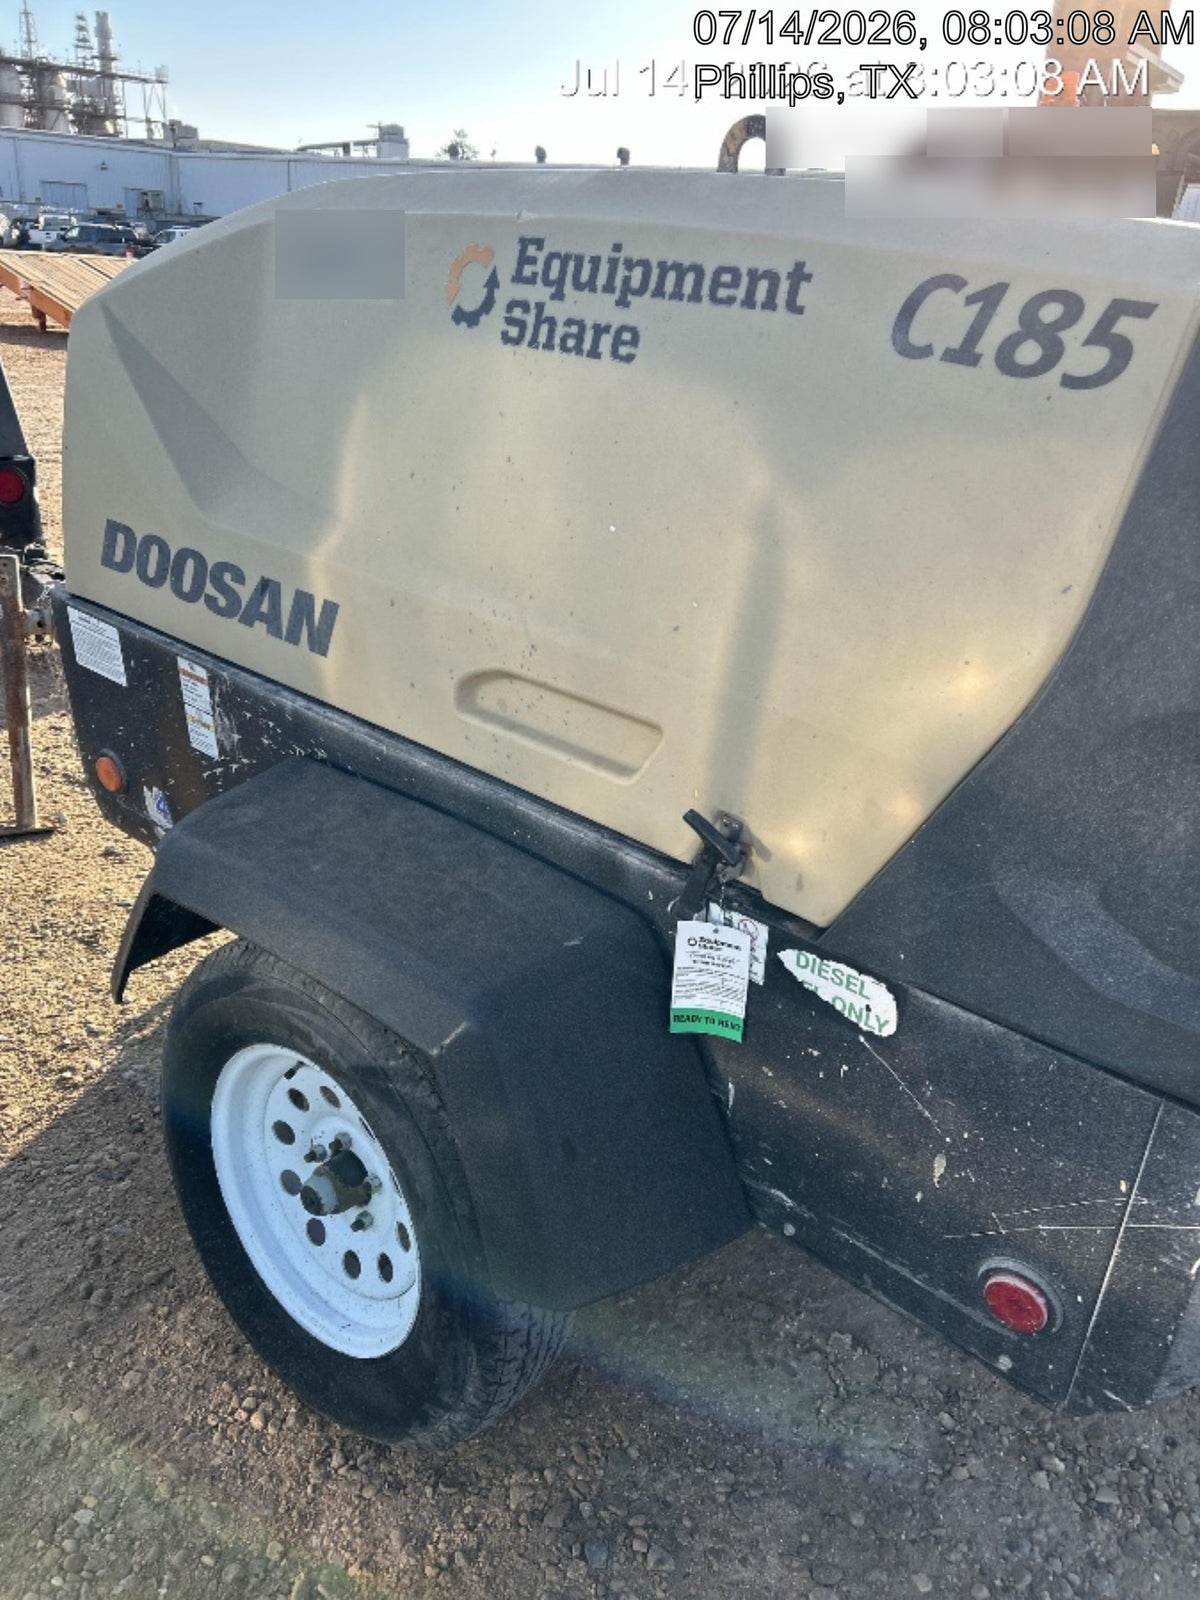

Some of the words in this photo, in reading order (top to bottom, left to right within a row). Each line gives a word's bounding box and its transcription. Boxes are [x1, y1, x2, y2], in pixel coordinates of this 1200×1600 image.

[510, 235, 813, 315] Equipment
[500, 299, 640, 364] Share
[891, 272, 1160, 390] C185
[100, 518, 340, 658] DOOSAN
[795, 950, 870, 1000] DIESEL
[831, 995, 890, 1034] ONLY
